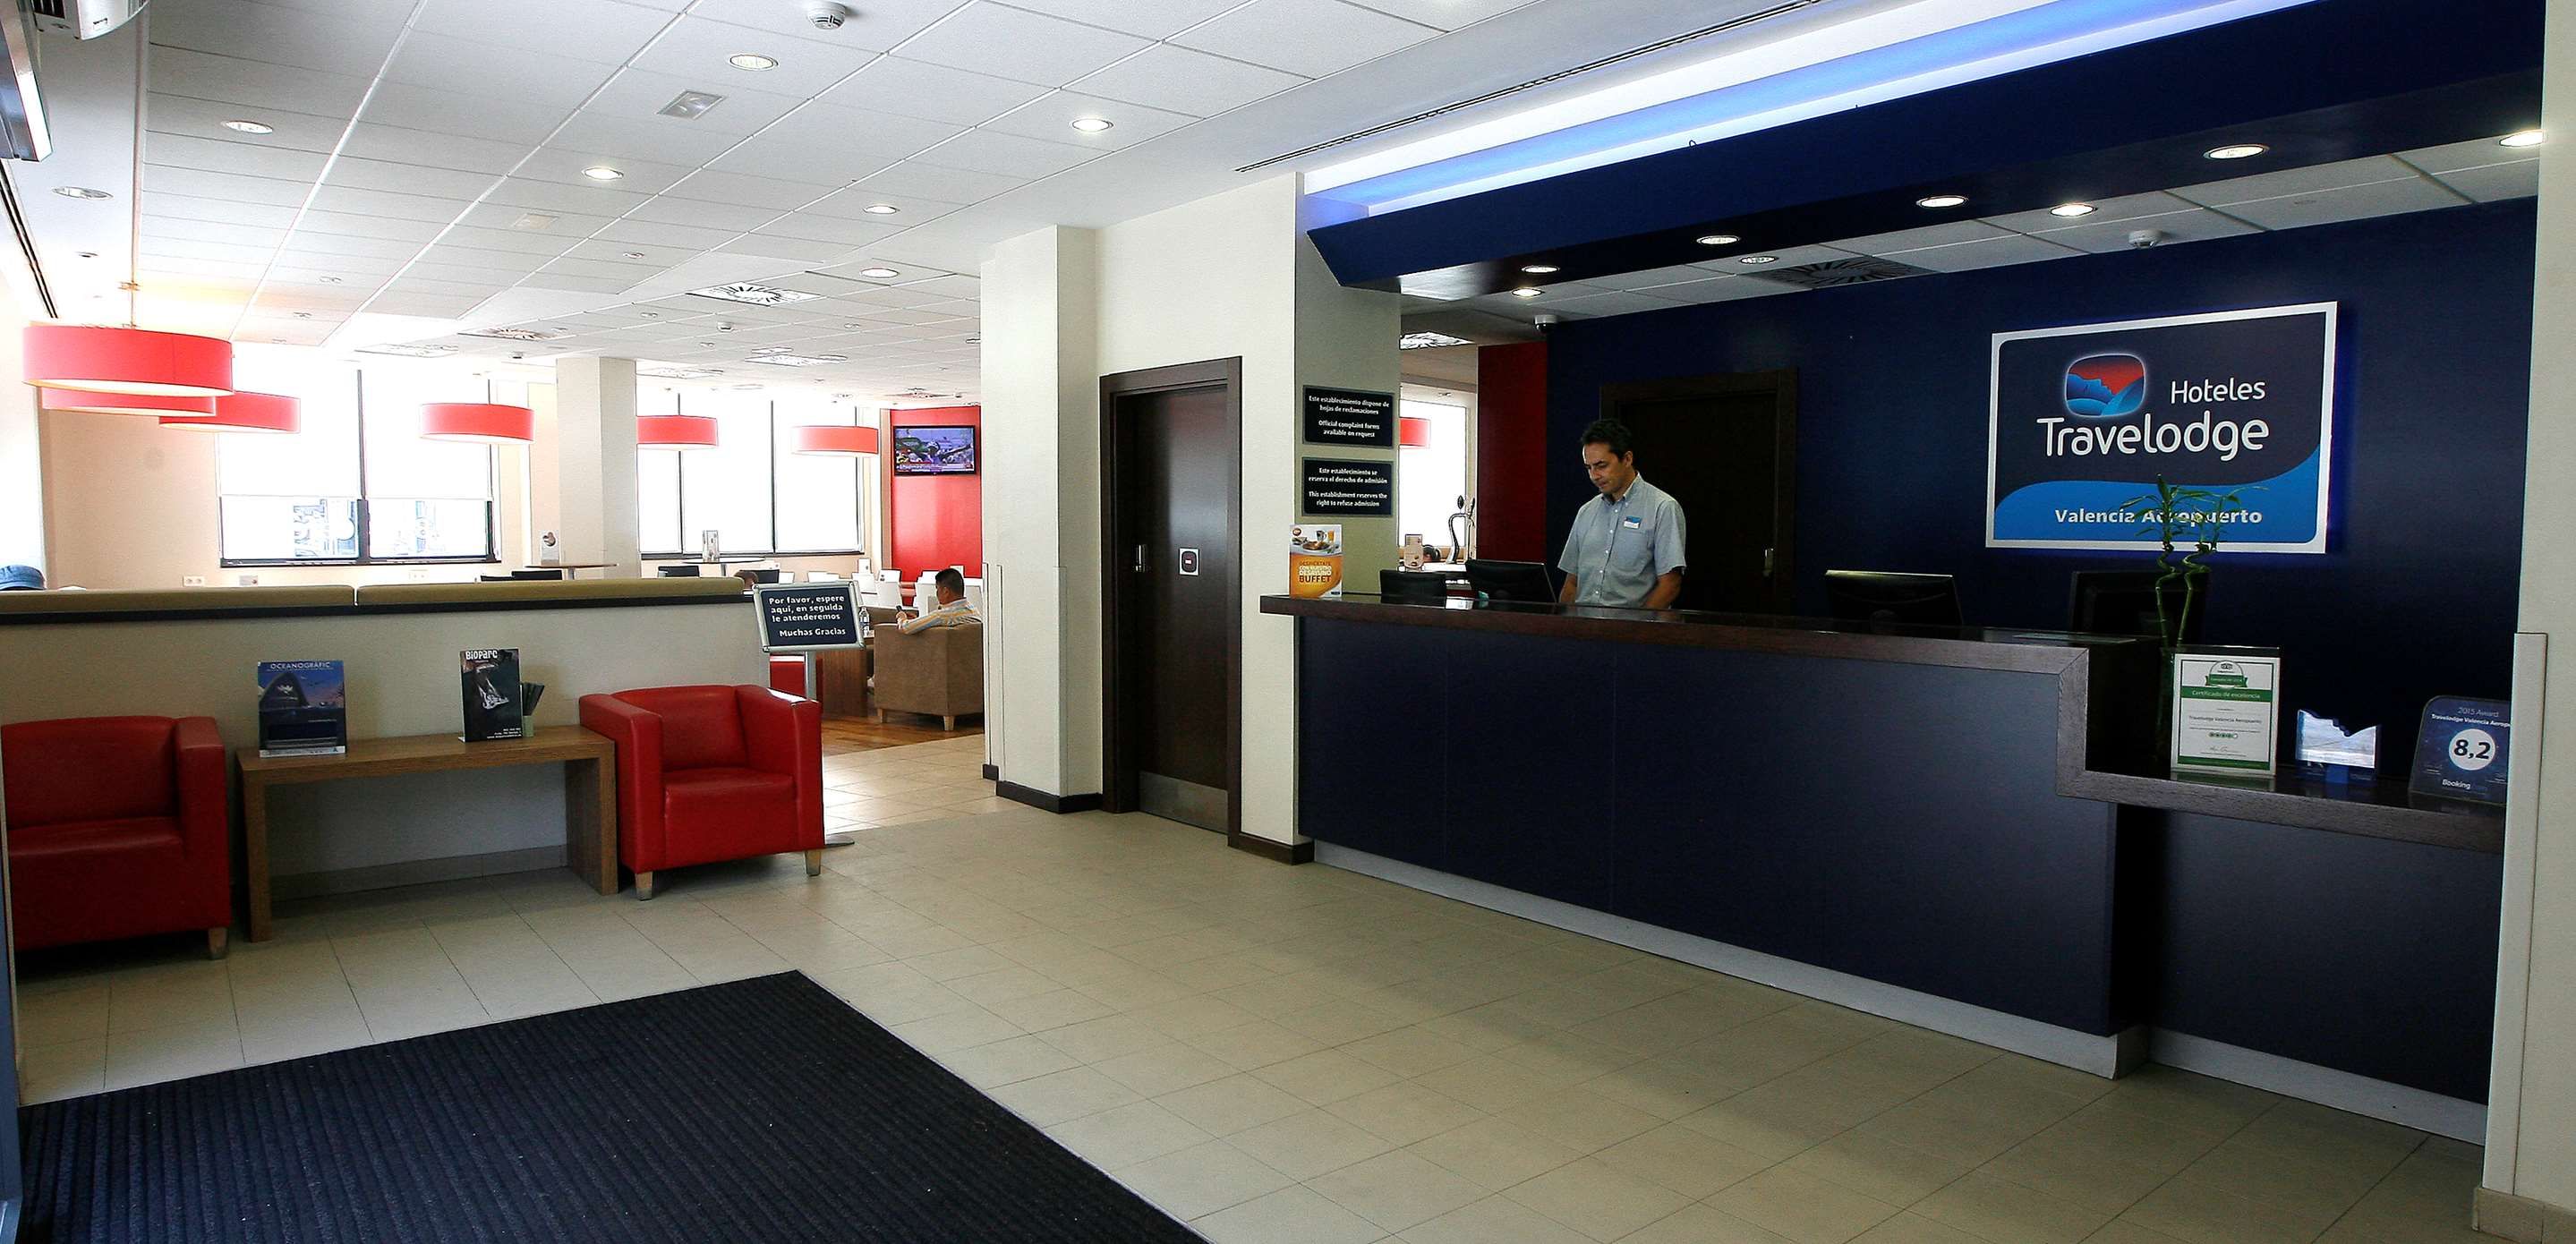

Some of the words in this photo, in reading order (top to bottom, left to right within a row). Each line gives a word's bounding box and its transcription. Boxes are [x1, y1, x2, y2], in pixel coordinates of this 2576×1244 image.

[2170, 377, 2266, 405] Hoteles
[1320, 396, 1361, 405] establecimiento
[2035, 409, 2270, 462] Travelodge
[2054, 508, 2136, 523] Valencia
[1299, 575, 1332, 583] BUFFET
[769, 597, 784, 605] Por
[786, 596, 815, 604] favor,
[771, 605, 794, 614] aquí,
[809, 603, 843, 612] seguida
[772, 615, 780, 623] le
[782, 613, 840, 621] atenderemos
[779, 628, 813, 637] Muchas
[815, 627, 846, 635] Gracias
[2458, 707, 2475, 715] 2015
[2476, 709, 2499, 717] Award
[2431, 713, 2463, 722] Travelodge
[2464, 717, 2489, 725] Valencia
[2453, 739, 2491, 759] 8,2
[2442, 779, 2470, 789] Booking
